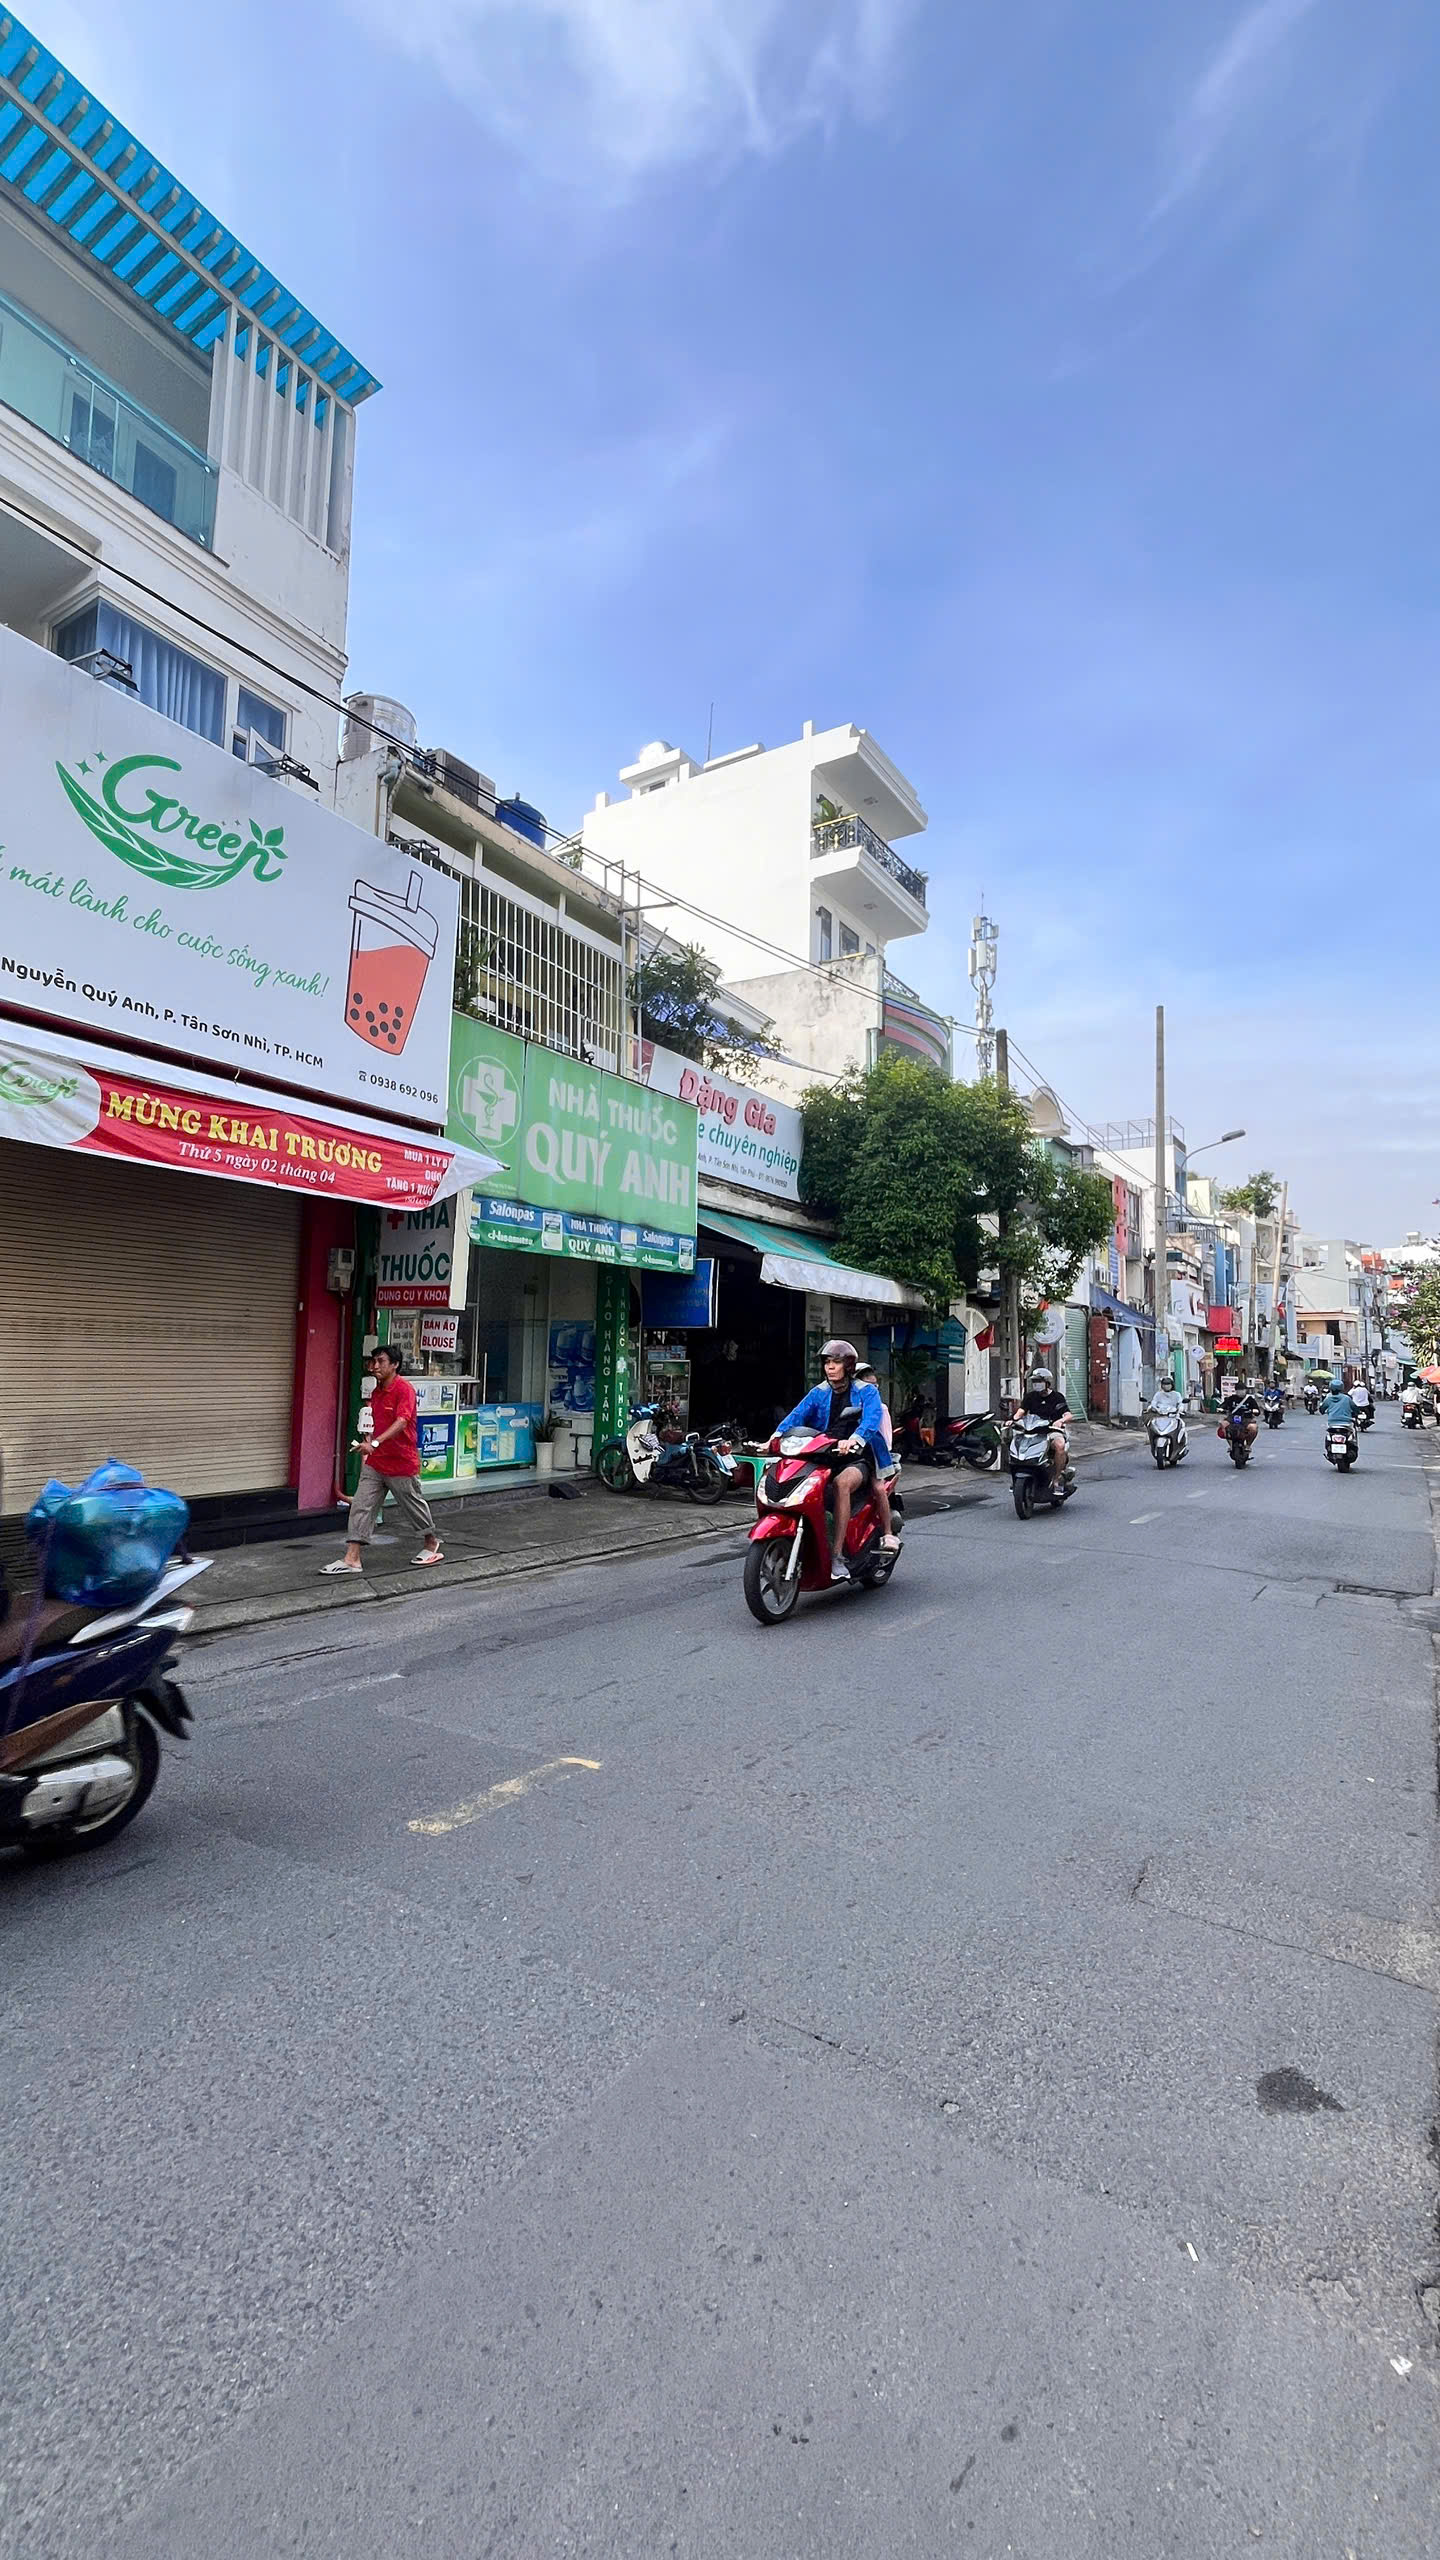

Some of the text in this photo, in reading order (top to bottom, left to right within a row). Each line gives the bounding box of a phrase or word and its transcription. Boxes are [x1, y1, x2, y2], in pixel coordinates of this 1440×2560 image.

[102, 754, 283, 882] Green
[10, 866, 330, 998] mát lành cho cuộc sống xanh!
[1, 957, 324, 1069] Nguyễn Quý Anh, P. Tân Sơn Nhì, TP. HCM
[369, 1073, 440, 1104] 0938 692 096
[548, 1078, 677, 1145] NHÀ THUỐC
[679, 1068, 776, 1136] Đặng Gia
[105, 1092, 382, 1173] MỪNG KHAI TRƯƠNG
[709, 1124, 757, 1157] chuyên
[758, 1146, 798, 1176] nghiệp
[179, 1141, 336, 1184] Thứ 5 ngày 02 tháng 04
[404, 1150, 424, 1164] MUA
[431, 1157, 442, 1169] LY
[526, 1122, 690, 1208] QUÝ ANH
[489, 1201, 535, 1222] Salonpas
[571, 1218, 587, 1233] NHÀ
[588, 1221, 614, 1238] THUỐC
[642, 1230, 675, 1248] Salonpas
[381, 1240, 450, 1281] THUỐC
[594, 1242, 616, 1258] ANH
[424, 1290, 448, 1301] KHOA
[421, 1335, 455, 1349] BLOUSE
